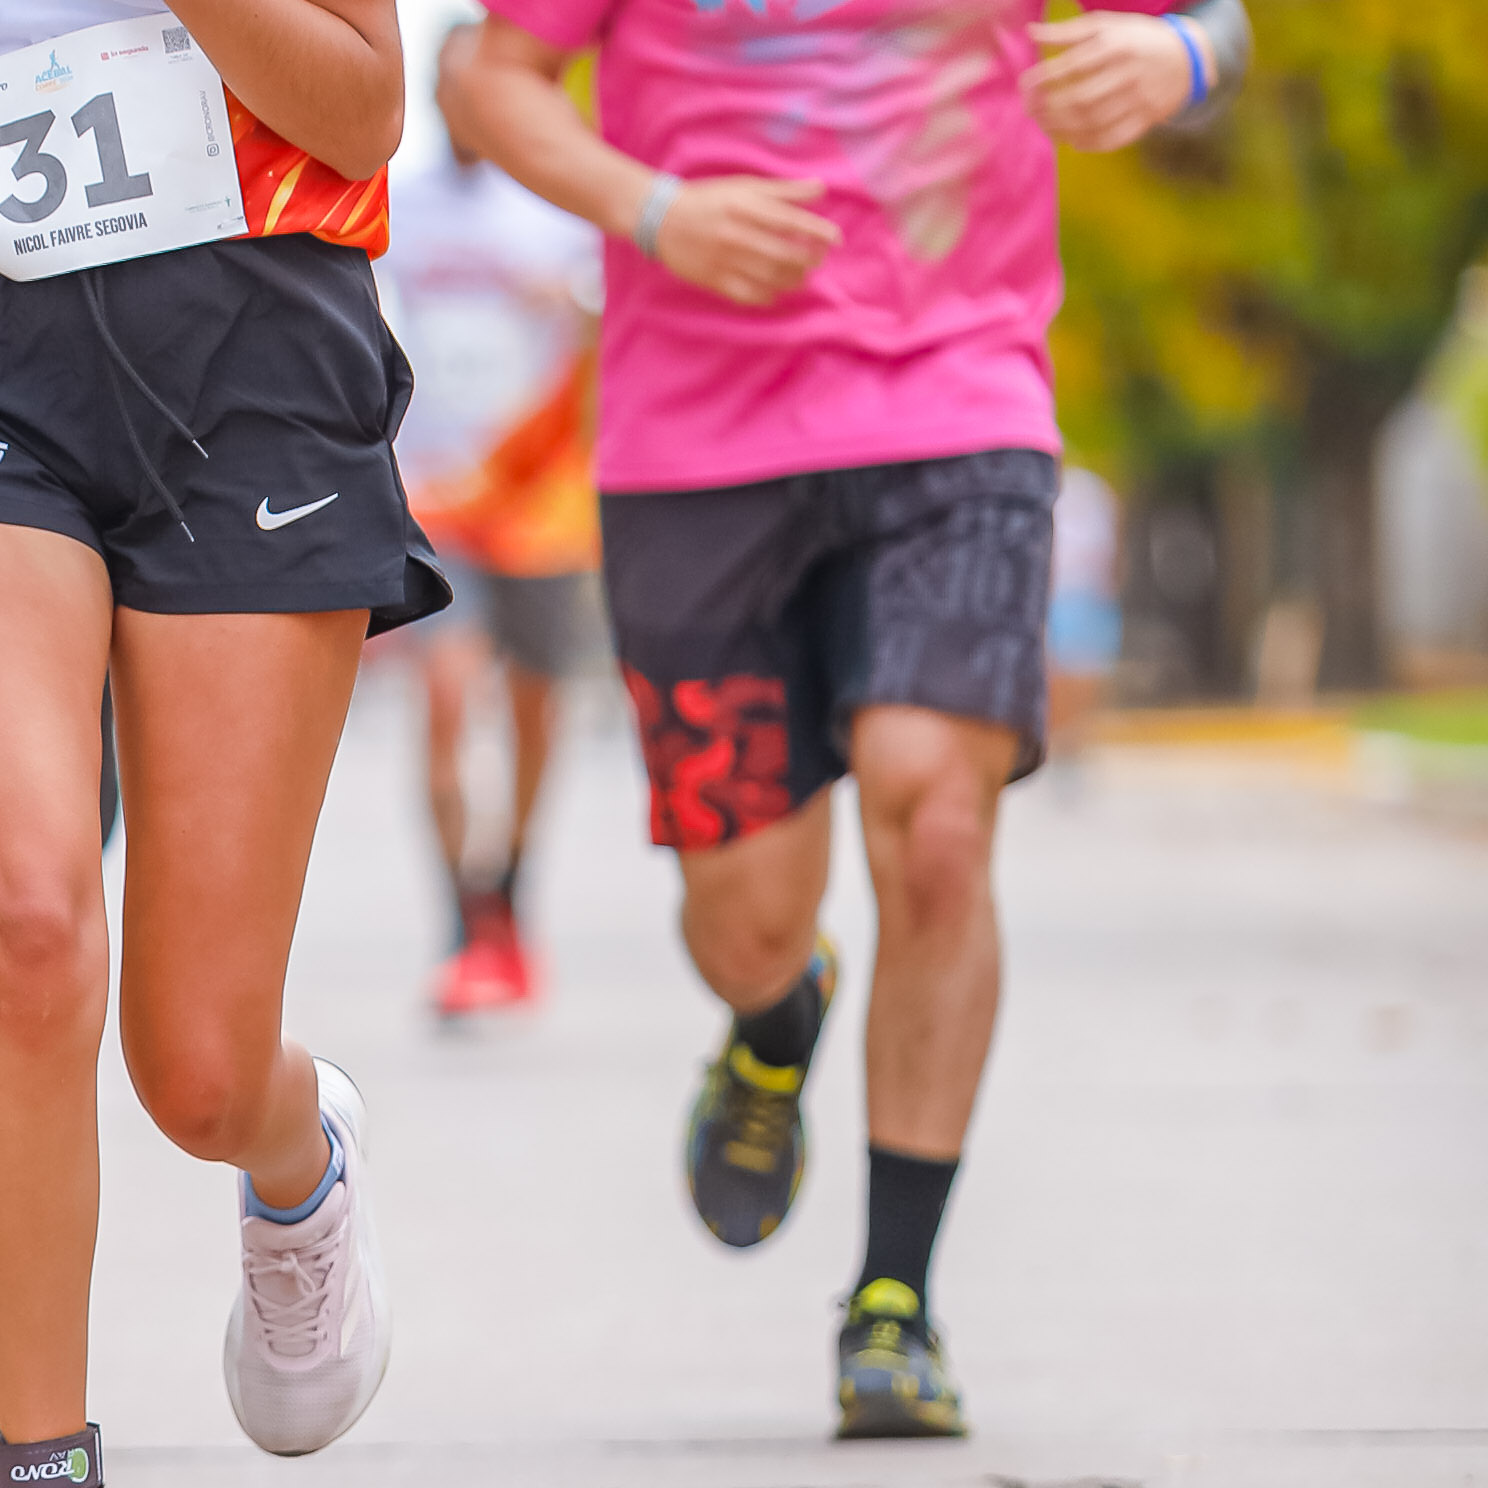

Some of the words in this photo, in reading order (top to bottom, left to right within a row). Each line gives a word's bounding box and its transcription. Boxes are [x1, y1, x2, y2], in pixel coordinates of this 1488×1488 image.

[13, 233, 49, 256] NICOL
[50, 222, 93, 248] FAIVRE
[94, 212, 148, 237] SEGOVIA
